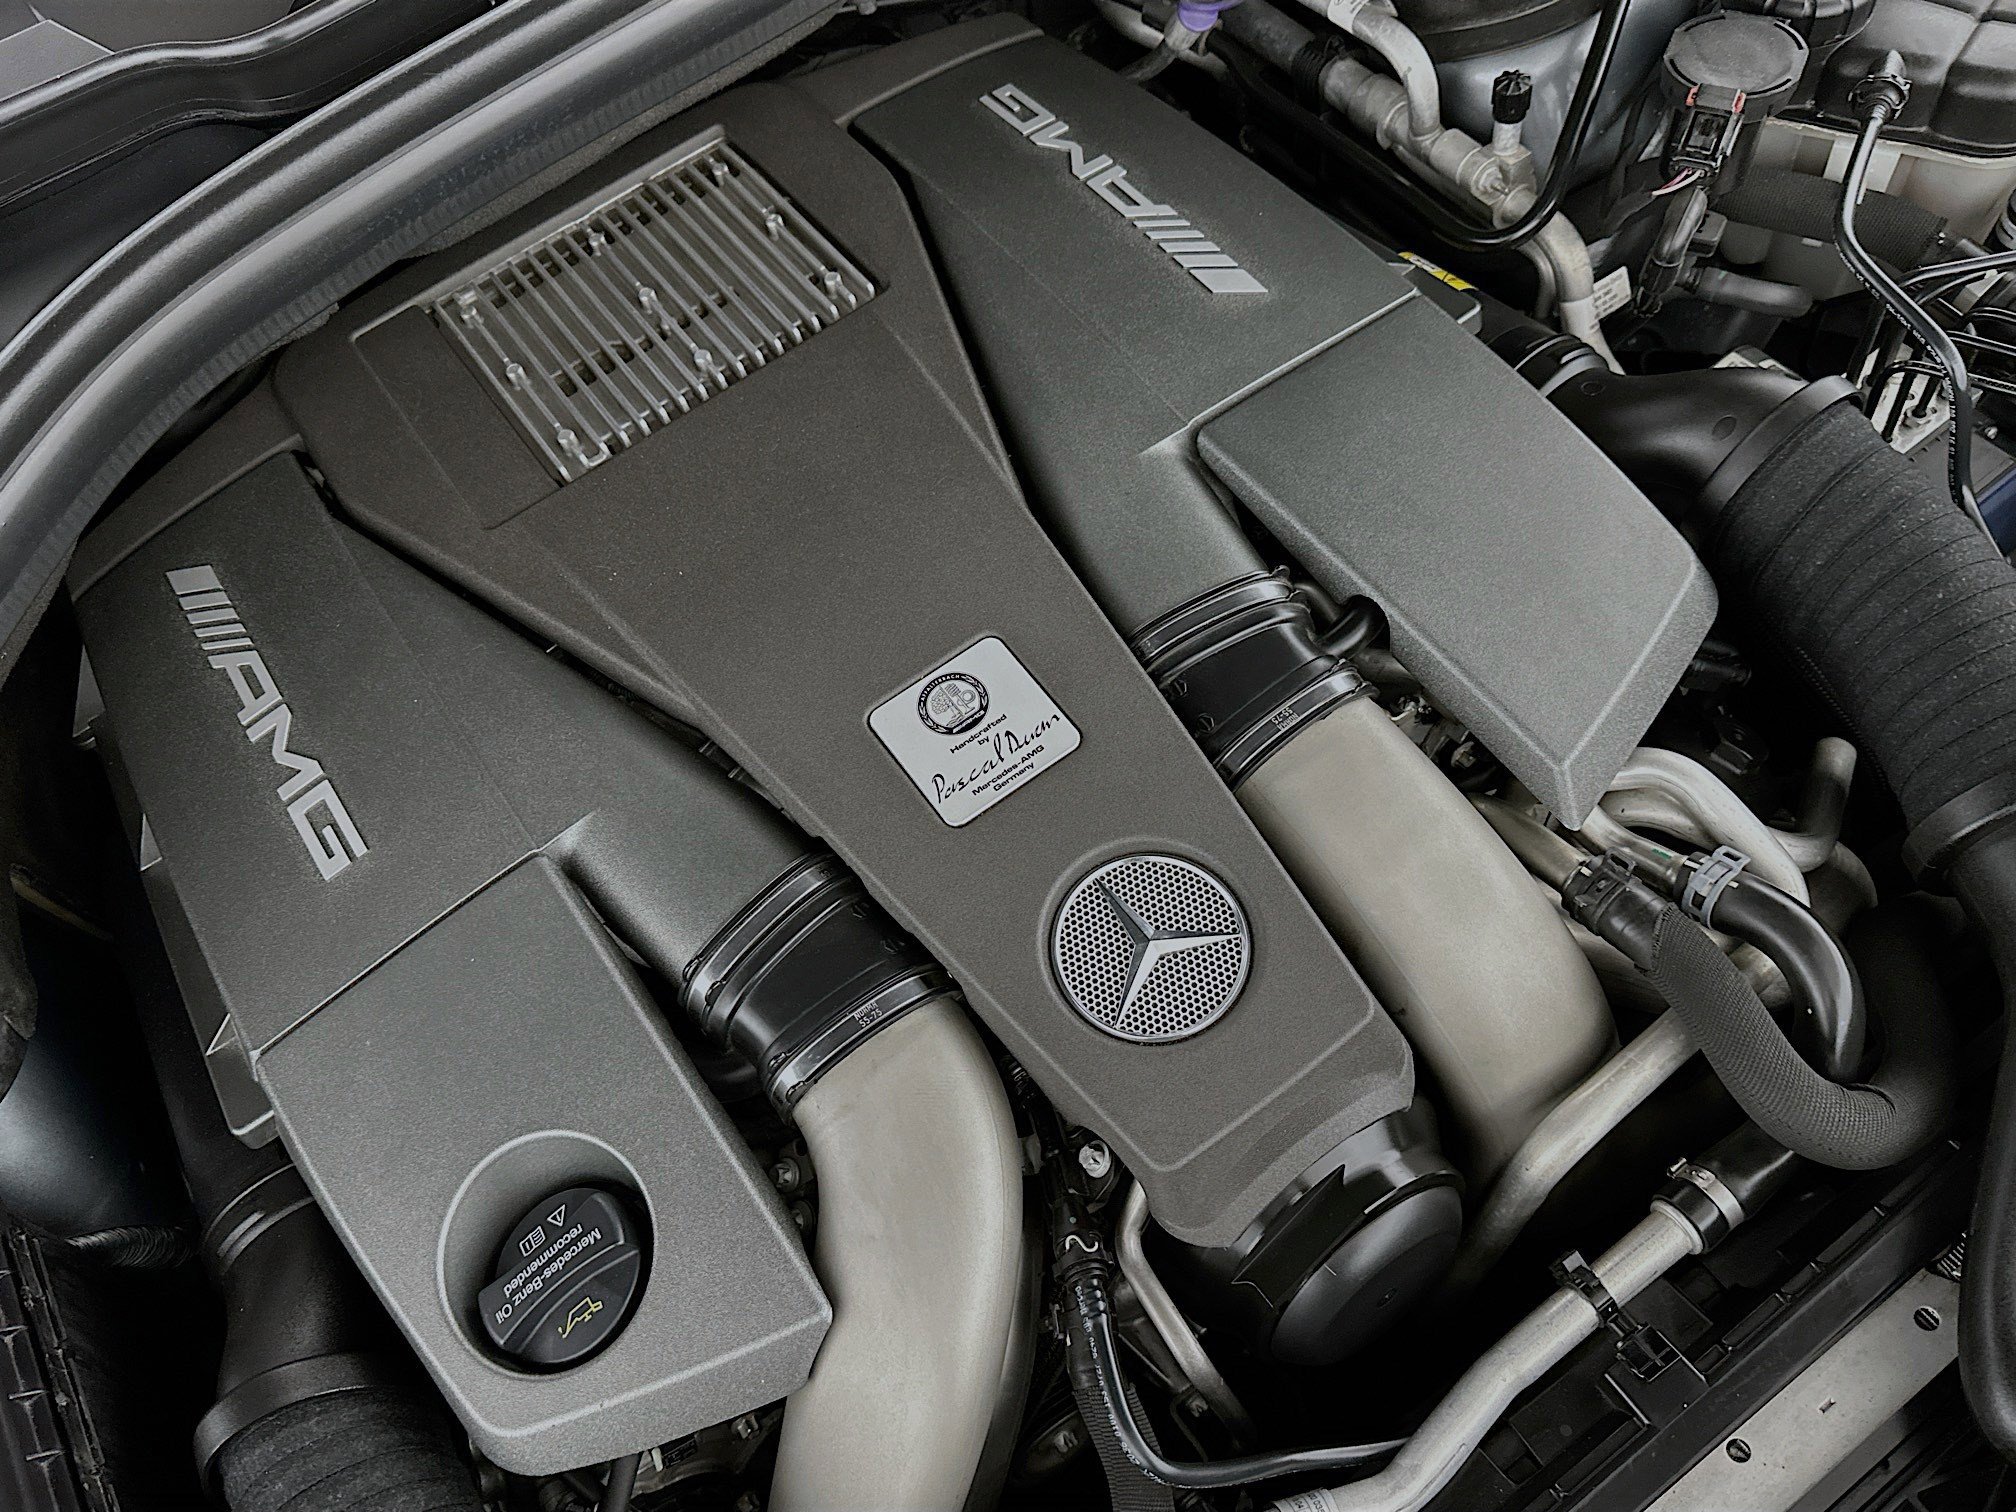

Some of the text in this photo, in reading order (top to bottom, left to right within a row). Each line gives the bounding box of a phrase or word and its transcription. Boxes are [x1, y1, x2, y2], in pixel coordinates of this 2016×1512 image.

[978, 83, 1178, 218] AMG
[207, 650, 370, 881] AMG
[931, 732, 1005, 804] Pascal
[949, 714, 1008, 754] Handcrafted
[971, 744, 1046, 796] Mercedes-AMG
[977, 735, 990, 746] by
[993, 762, 1035, 792] Germany
[495, 1227, 602, 1324] Mercedes-Benz Oil
[503, 1223, 583, 1298] recommended
